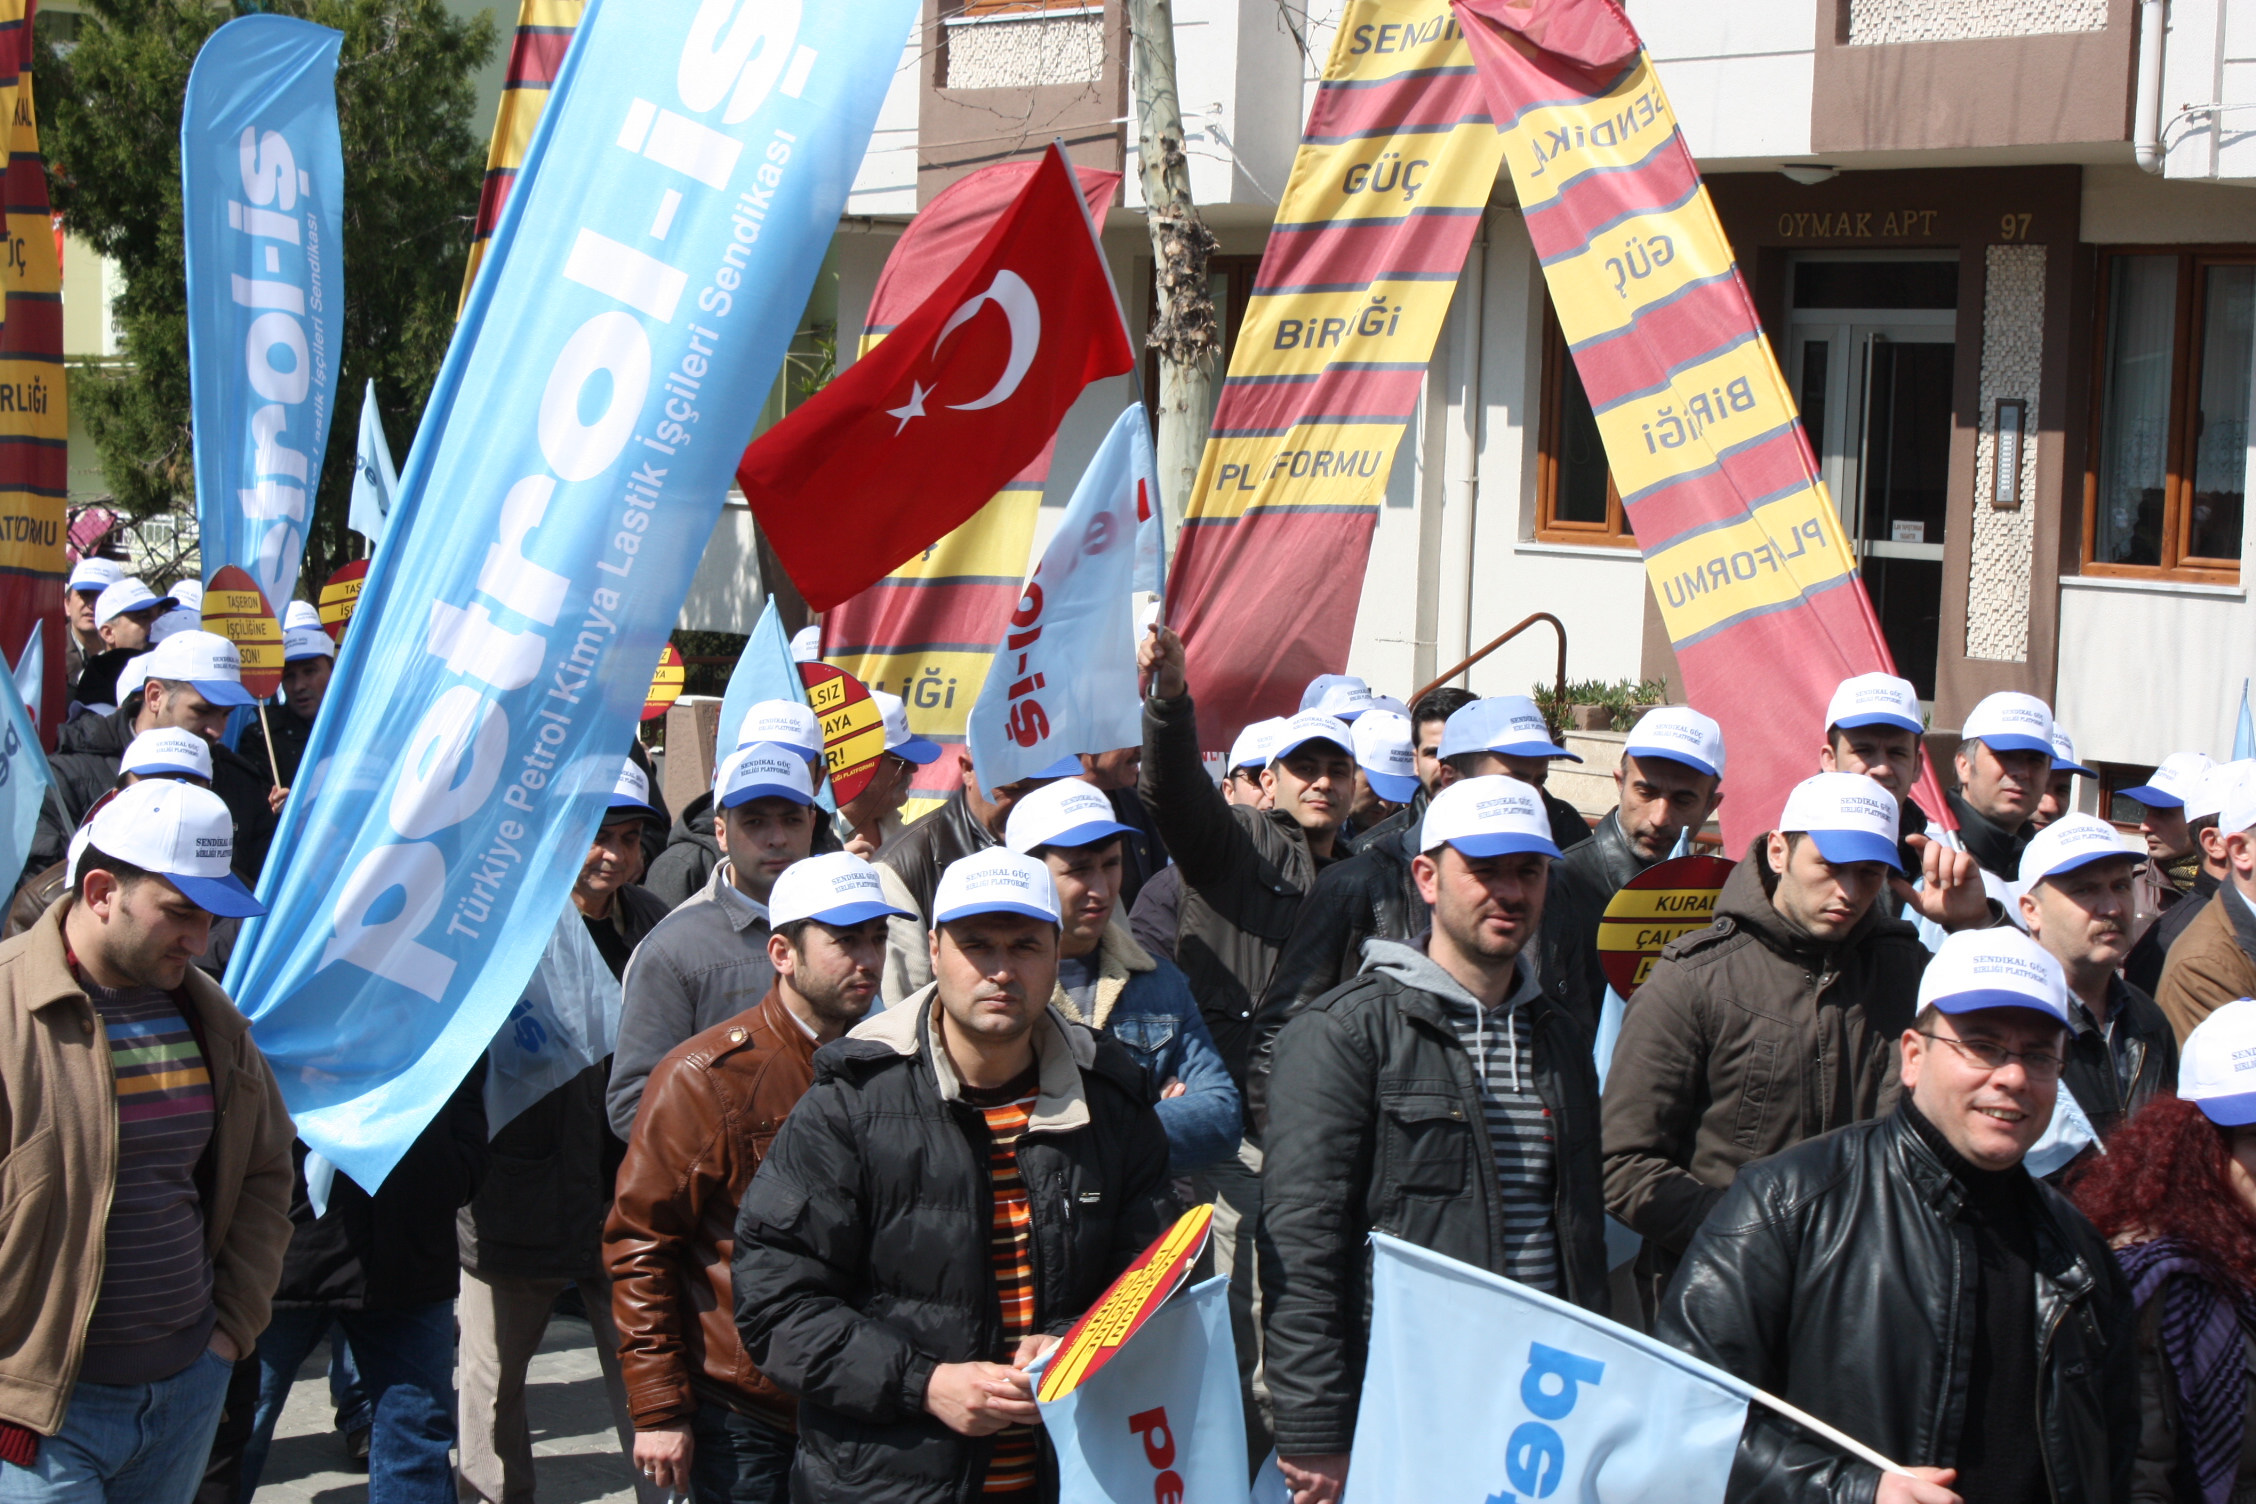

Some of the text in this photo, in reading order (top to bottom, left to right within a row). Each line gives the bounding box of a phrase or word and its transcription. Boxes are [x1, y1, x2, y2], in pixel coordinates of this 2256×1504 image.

[1342, 152, 1429, 202] GÜÇ
[1778, 210, 1937, 238] OYMAK APT
[2001, 213, 2032, 240] 97
[446, 808, 524, 940] Türkiye
[503, 709, 573, 814] Petrol
[548, 587, 620, 706] Kimya
[598, 464, 668, 579] Lastik
[698, 128, 797, 318] Sendikası
[227, 595, 258, 612] TAŞERON
[241, 649, 261, 664] SON!
[1655, 896, 1715, 911] KURAL
